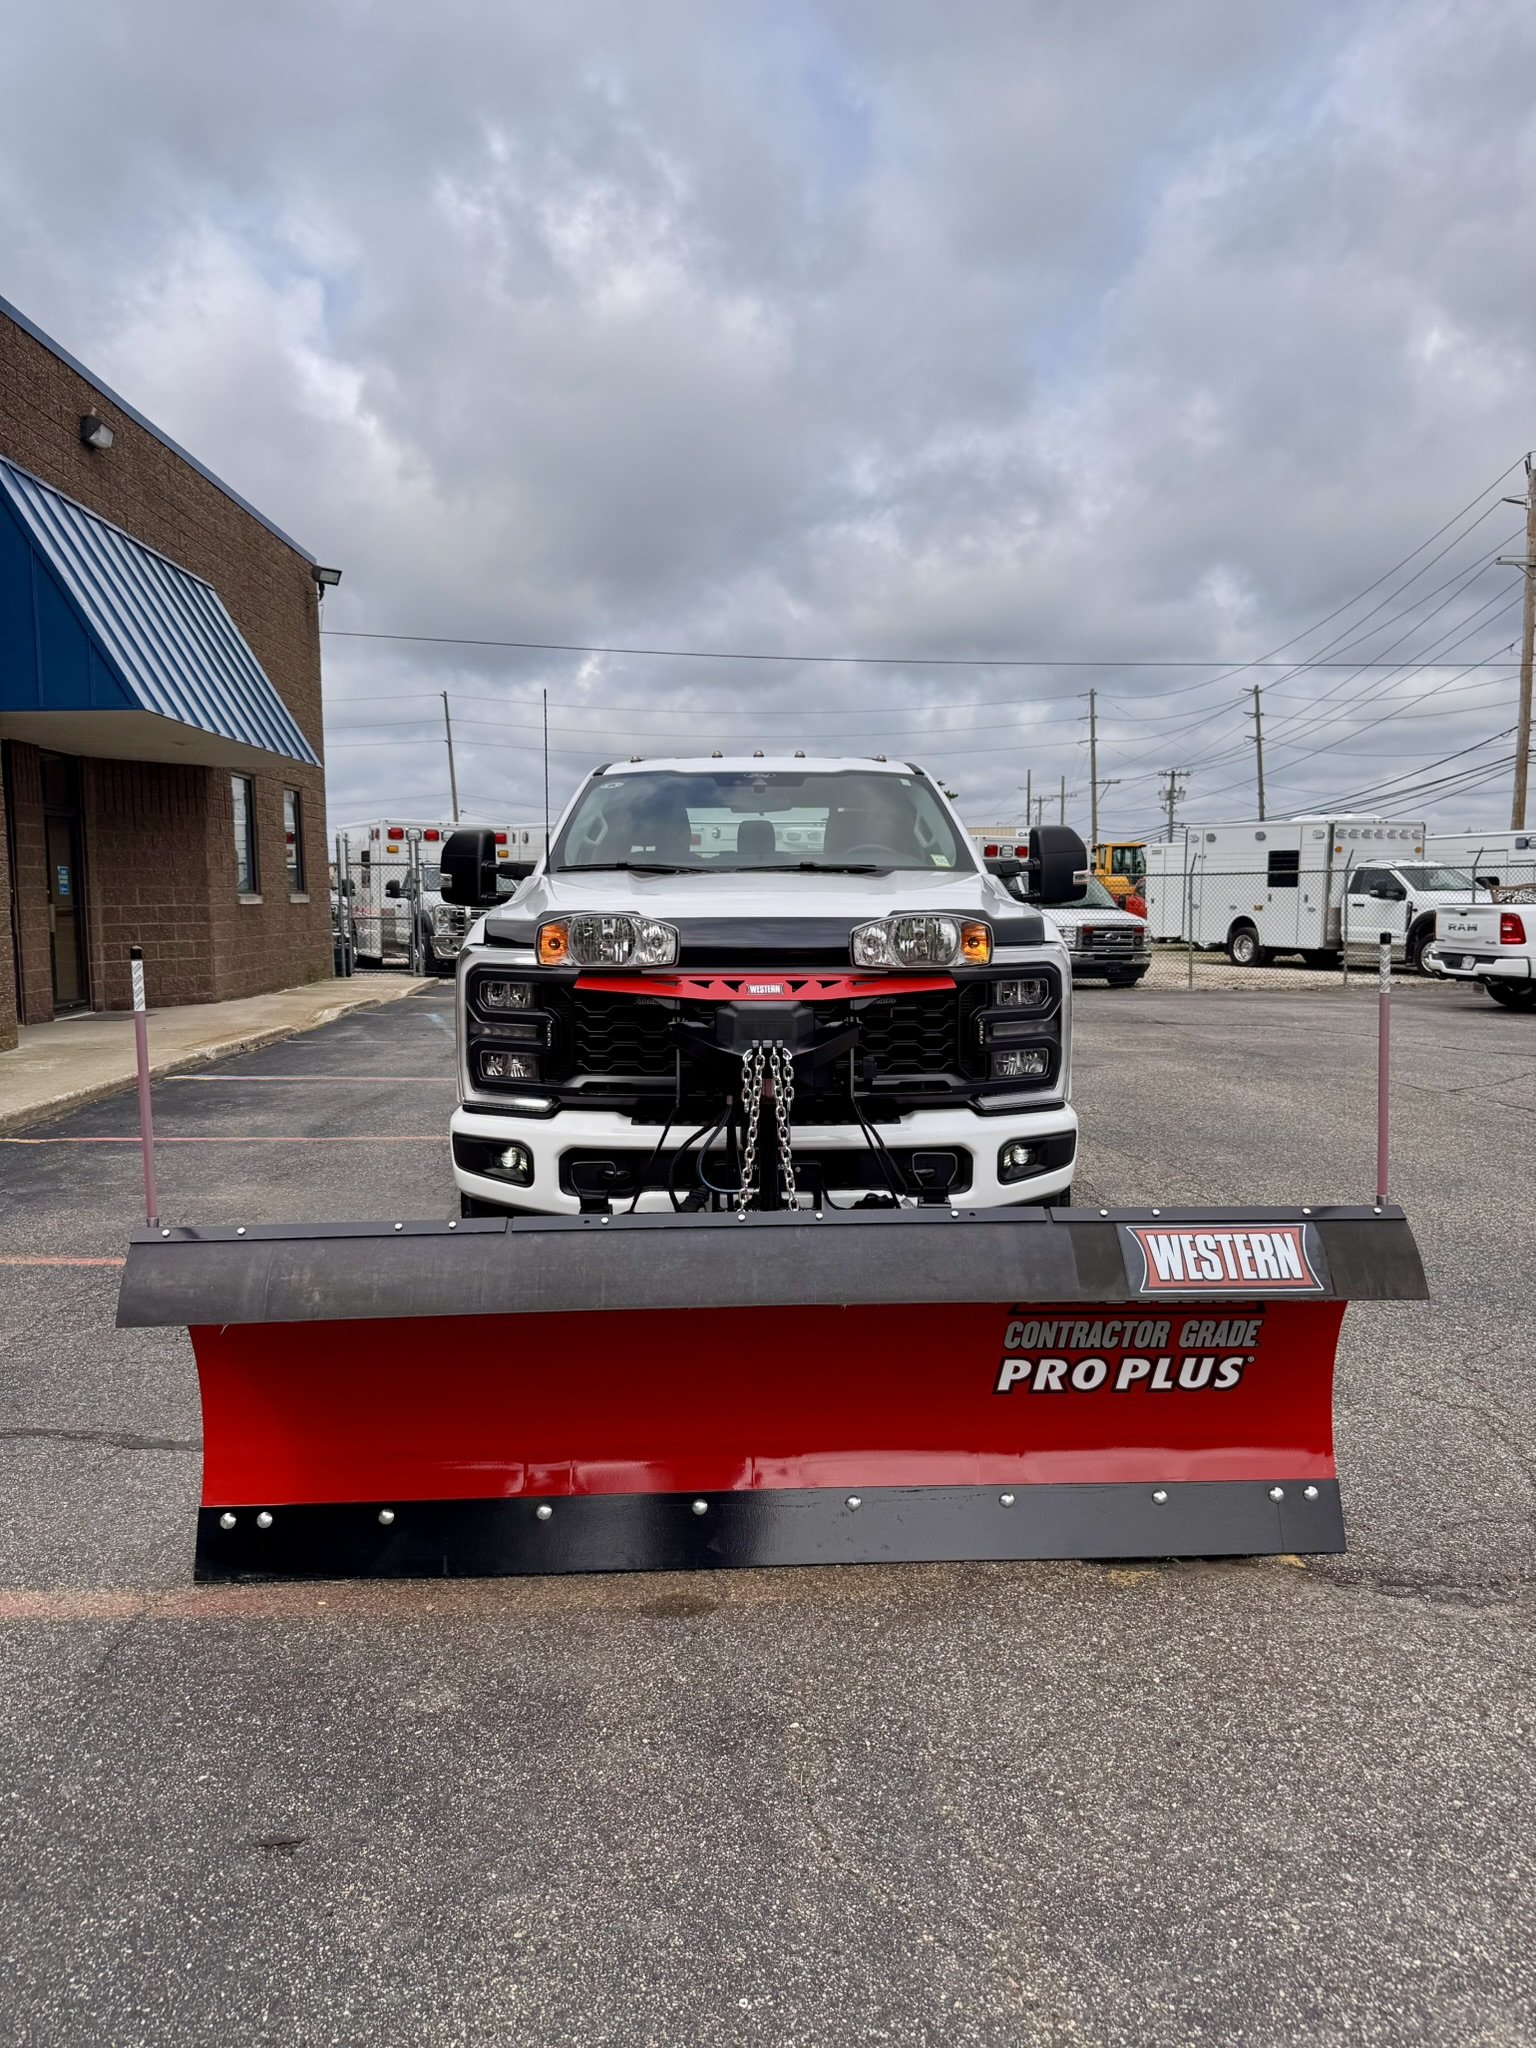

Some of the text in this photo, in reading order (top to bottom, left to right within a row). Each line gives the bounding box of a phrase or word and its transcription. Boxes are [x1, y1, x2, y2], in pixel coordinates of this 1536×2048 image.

[1448, 923, 1478, 932] RAM
[750, 985, 781, 994] WESTERN
[1145, 1232, 1304, 1282] WESTERN
[1003, 1319, 1264, 1350] CONTRACTOR GRADE
[996, 1357, 1108, 1391] PRO
